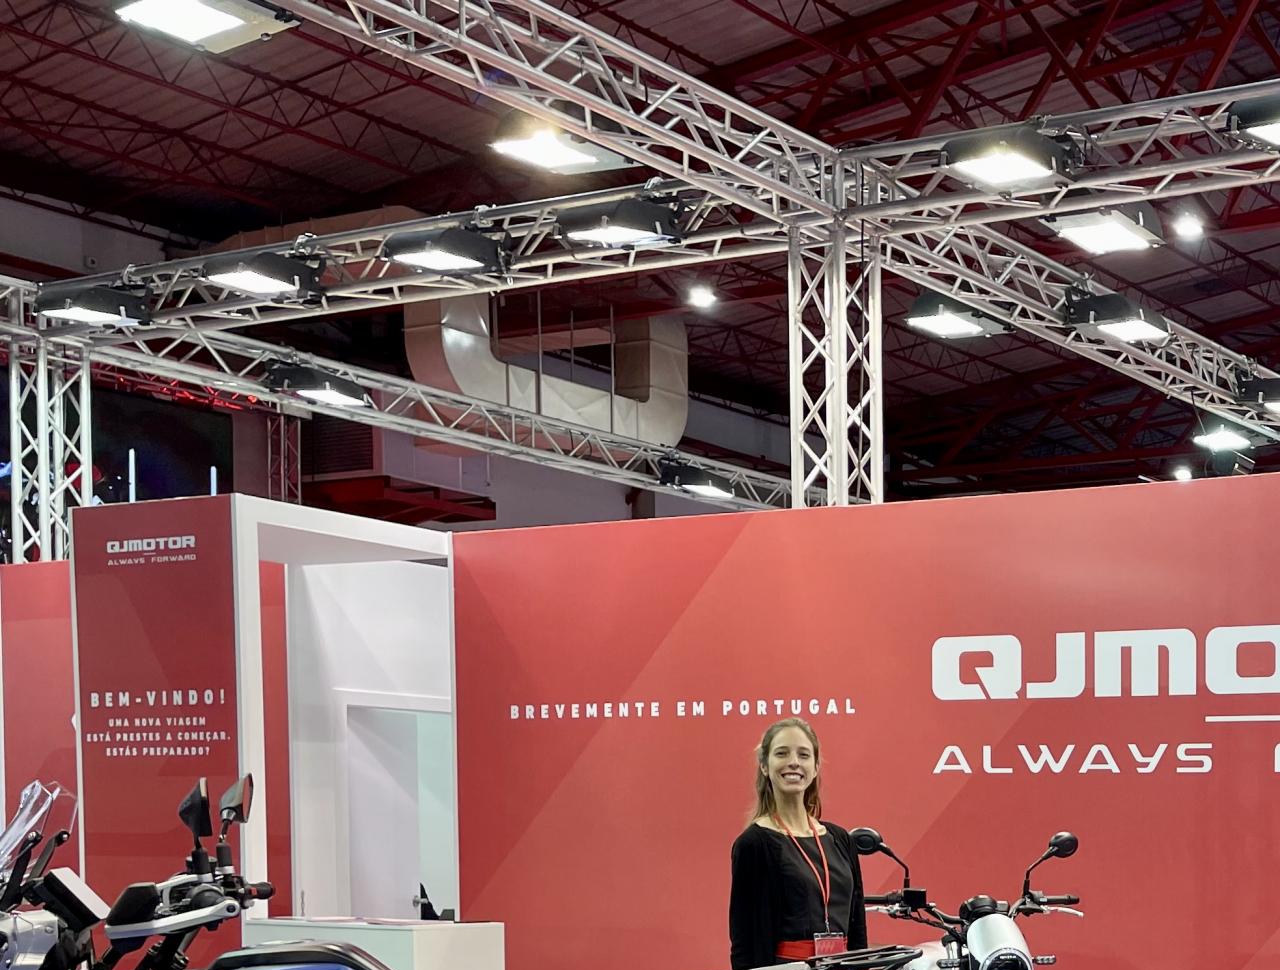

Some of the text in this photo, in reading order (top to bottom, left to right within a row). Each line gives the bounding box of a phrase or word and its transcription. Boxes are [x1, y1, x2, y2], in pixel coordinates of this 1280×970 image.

[106, 535, 196, 554] QJMOTOR
[107, 554, 197, 566] ALWAYS FORWARD
[90, 688, 225, 708] BEM-VINDO!
[510, 698, 856, 719] BREVEMENTE EM PORTUGAL
[108, 716, 206, 727] UMA NOVA VIAGEM
[86, 731, 231, 742] ESTÁ PRESTES A COMEÇAR.
[106, 745, 210, 757] ESTÁS PREPARADO?
[932, 743, 1213, 774] ALWAYS
